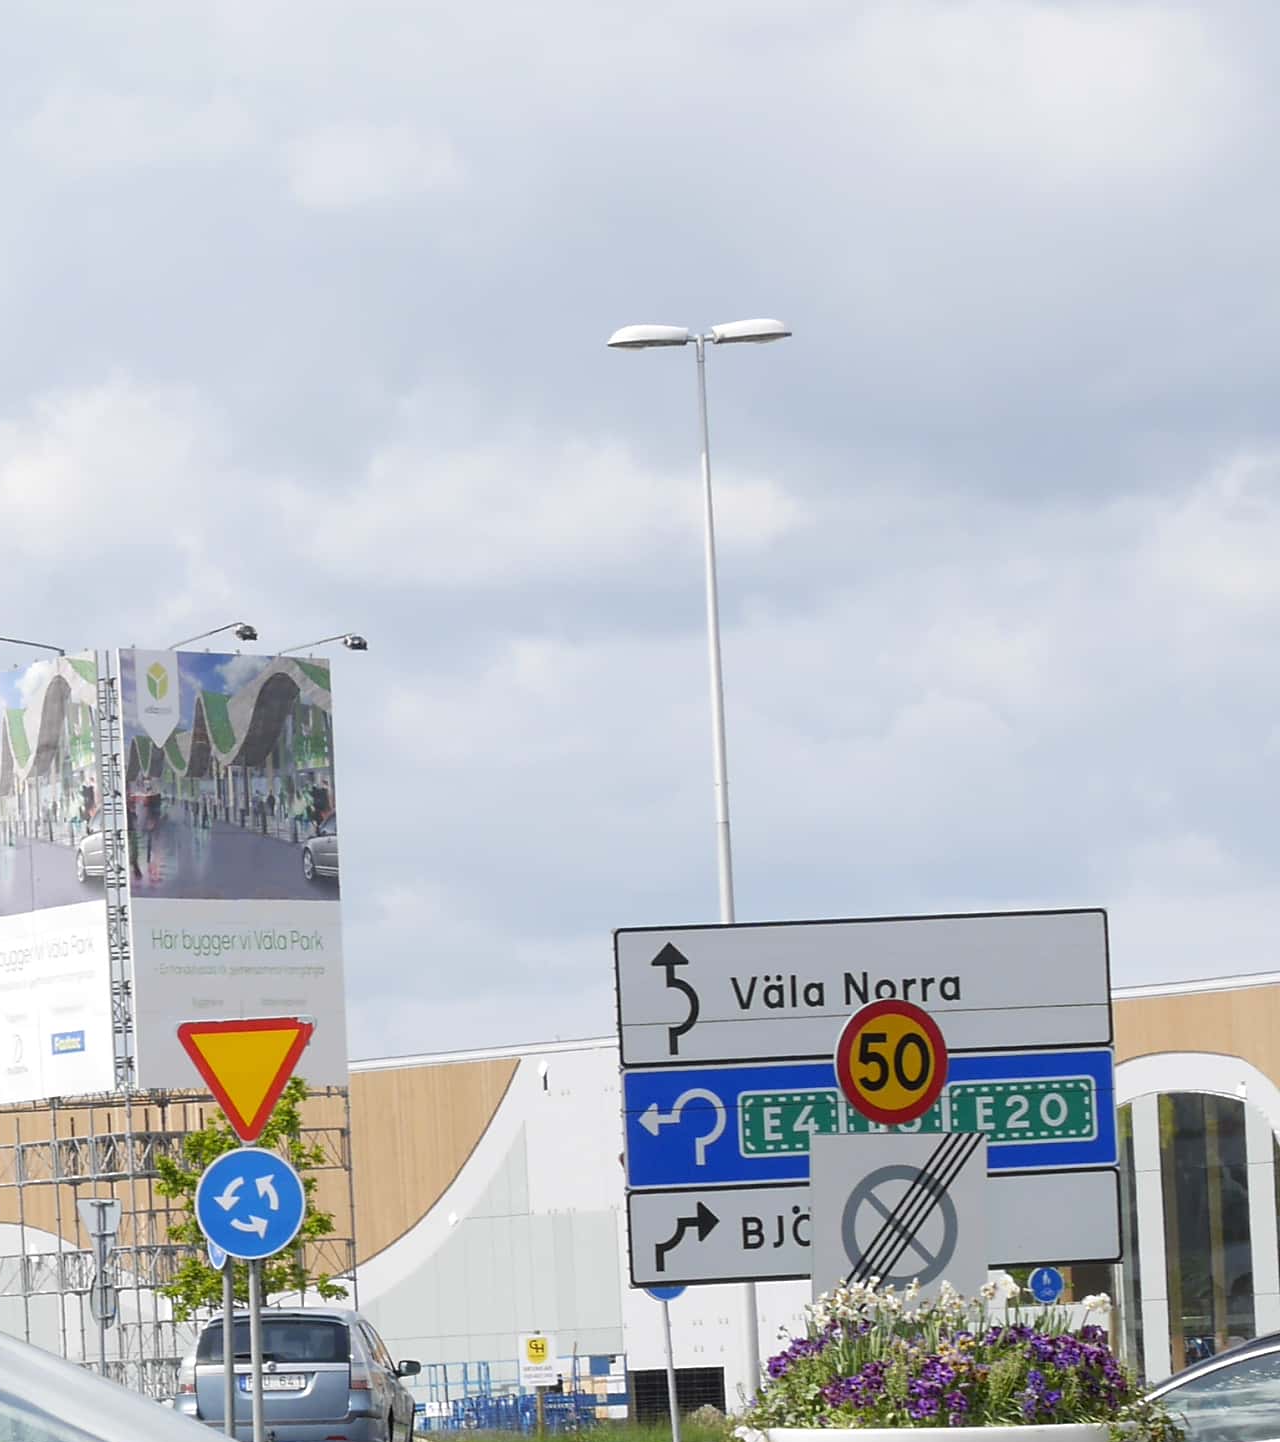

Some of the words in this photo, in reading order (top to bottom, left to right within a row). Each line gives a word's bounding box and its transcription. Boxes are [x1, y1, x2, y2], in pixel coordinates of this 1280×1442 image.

[152, 929, 178, 950] Här
[182, 929, 236, 956] bygger
[240, 930, 251, 950] vi
[254, 929, 288, 951] Väla
[291, 930, 323, 951] Park
[730, 974, 825, 1010] Väla
[843, 971, 961, 1006] Norra
[857, 1032, 932, 1092] 50
[762, 1104, 820, 1141] E4
[976, 1092, 1069, 1131] E20
